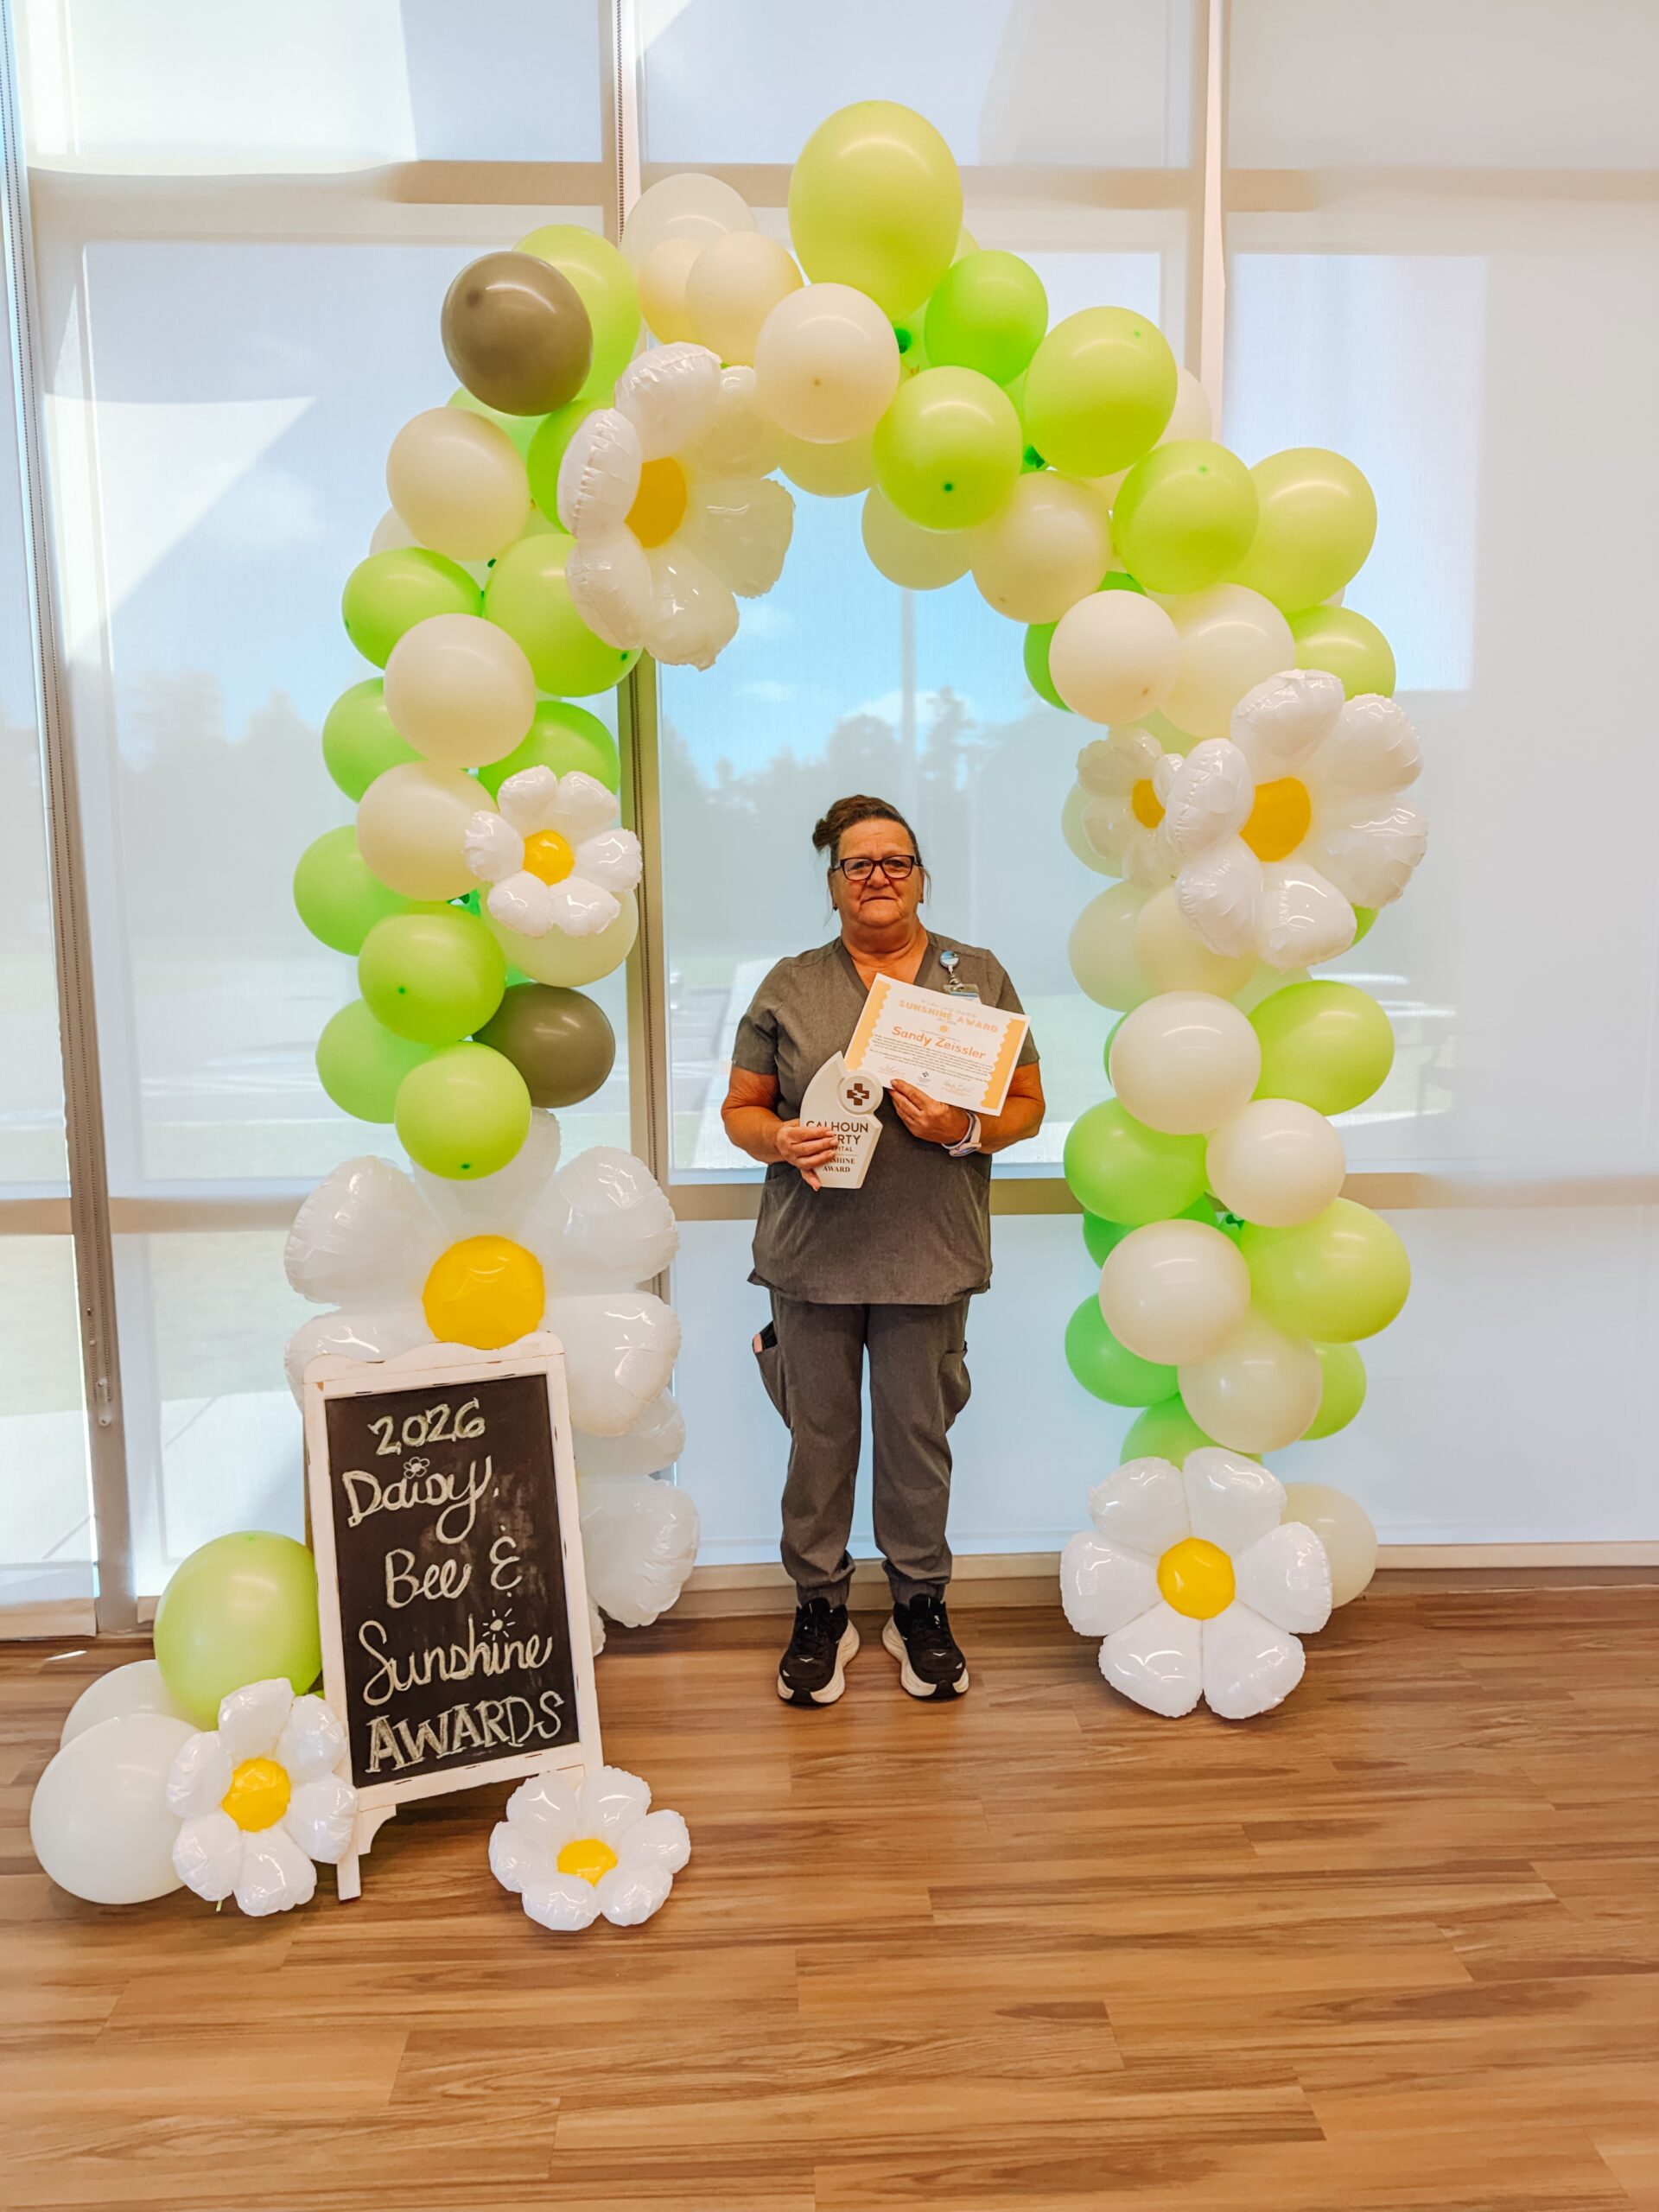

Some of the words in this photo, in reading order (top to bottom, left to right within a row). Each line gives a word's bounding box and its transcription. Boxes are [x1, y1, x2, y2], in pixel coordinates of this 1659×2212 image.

[891, 1026, 932, 1046] Sandy
[935, 1037, 987, 1059] Zeissler
[899, 999, 954, 1020] SUNSHINE
[957, 1014, 999, 1033] AWARD
[367, 1396, 486, 1456] 2026
[385, 1548, 472, 1609] Bee
[489, 1525, 524, 1598] &
[358, 1611, 553, 1706] Sunshine
[365, 1690, 565, 1774] AWARDS
